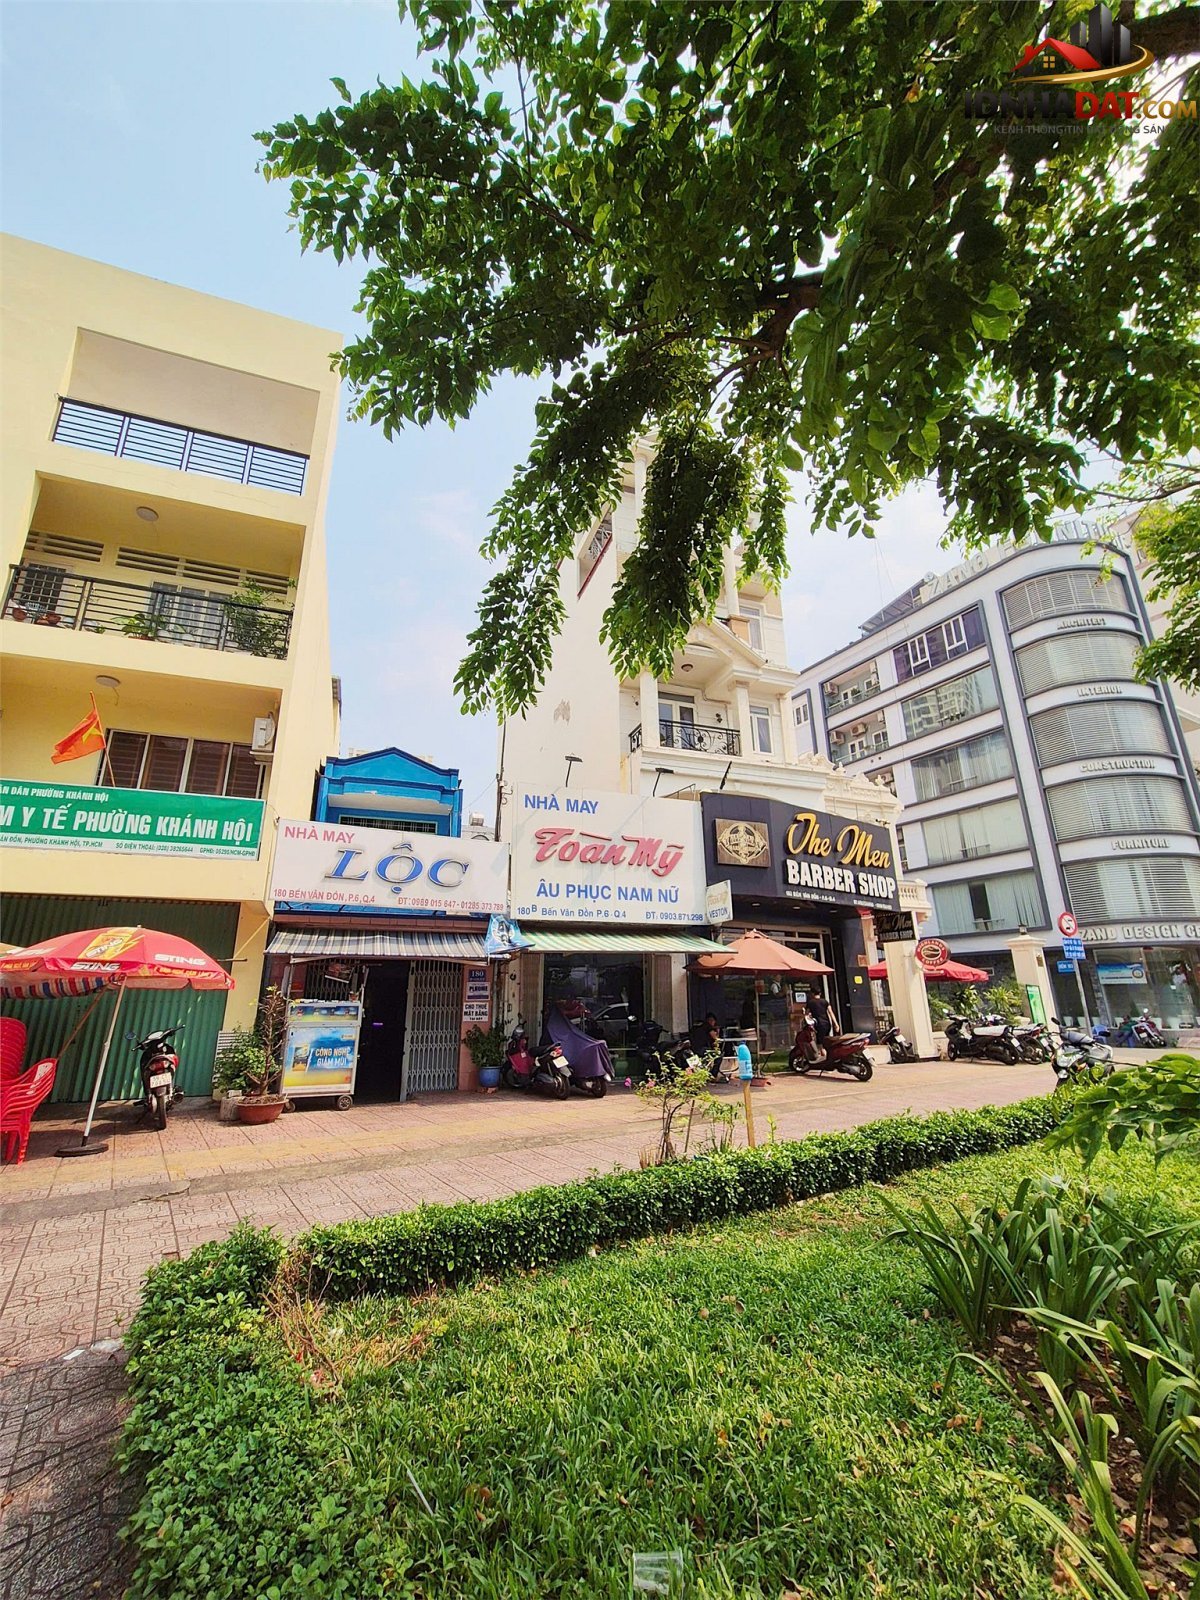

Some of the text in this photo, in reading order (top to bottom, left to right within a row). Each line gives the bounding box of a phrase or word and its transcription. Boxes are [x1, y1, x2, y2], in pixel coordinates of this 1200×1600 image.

[1057, 617, 1106, 630] ARCHITECT
[1077, 685, 1122, 698] INTERIOR
[1080, 758, 1156, 773] CONSTRUCTION
[523, 794, 599, 815] NHÀ MAY
[21, 806, 37, 827] Y
[42, 803, 73, 830] TẾ
[72, 808, 152, 836] PHƯỜNG
[155, 813, 219, 840] KHÁNH
[221, 818, 254, 846] HỘI
[284, 826, 355, 844] NHÀ MAY
[785, 813, 891, 869] The Men
[1112, 837, 1170, 850] FURNITURE
[535, 827, 627, 866] Toàn
[324, 843, 470, 895] LỘC
[786, 859, 897, 900] BARBER SHOP
[273, 888, 287, 898] 180
[536, 878, 680, 904] ÂU PHỤC NAM NỮ
[430, 900, 443, 908] 015
[481, 902, 493, 911] 373
[493, 903, 504, 911] 789
[1123, 924, 1181, 940] DESIGN
[85, 936, 125, 958] STING
[70, 961, 121, 972] STING
[154, 953, 206, 966] STING
